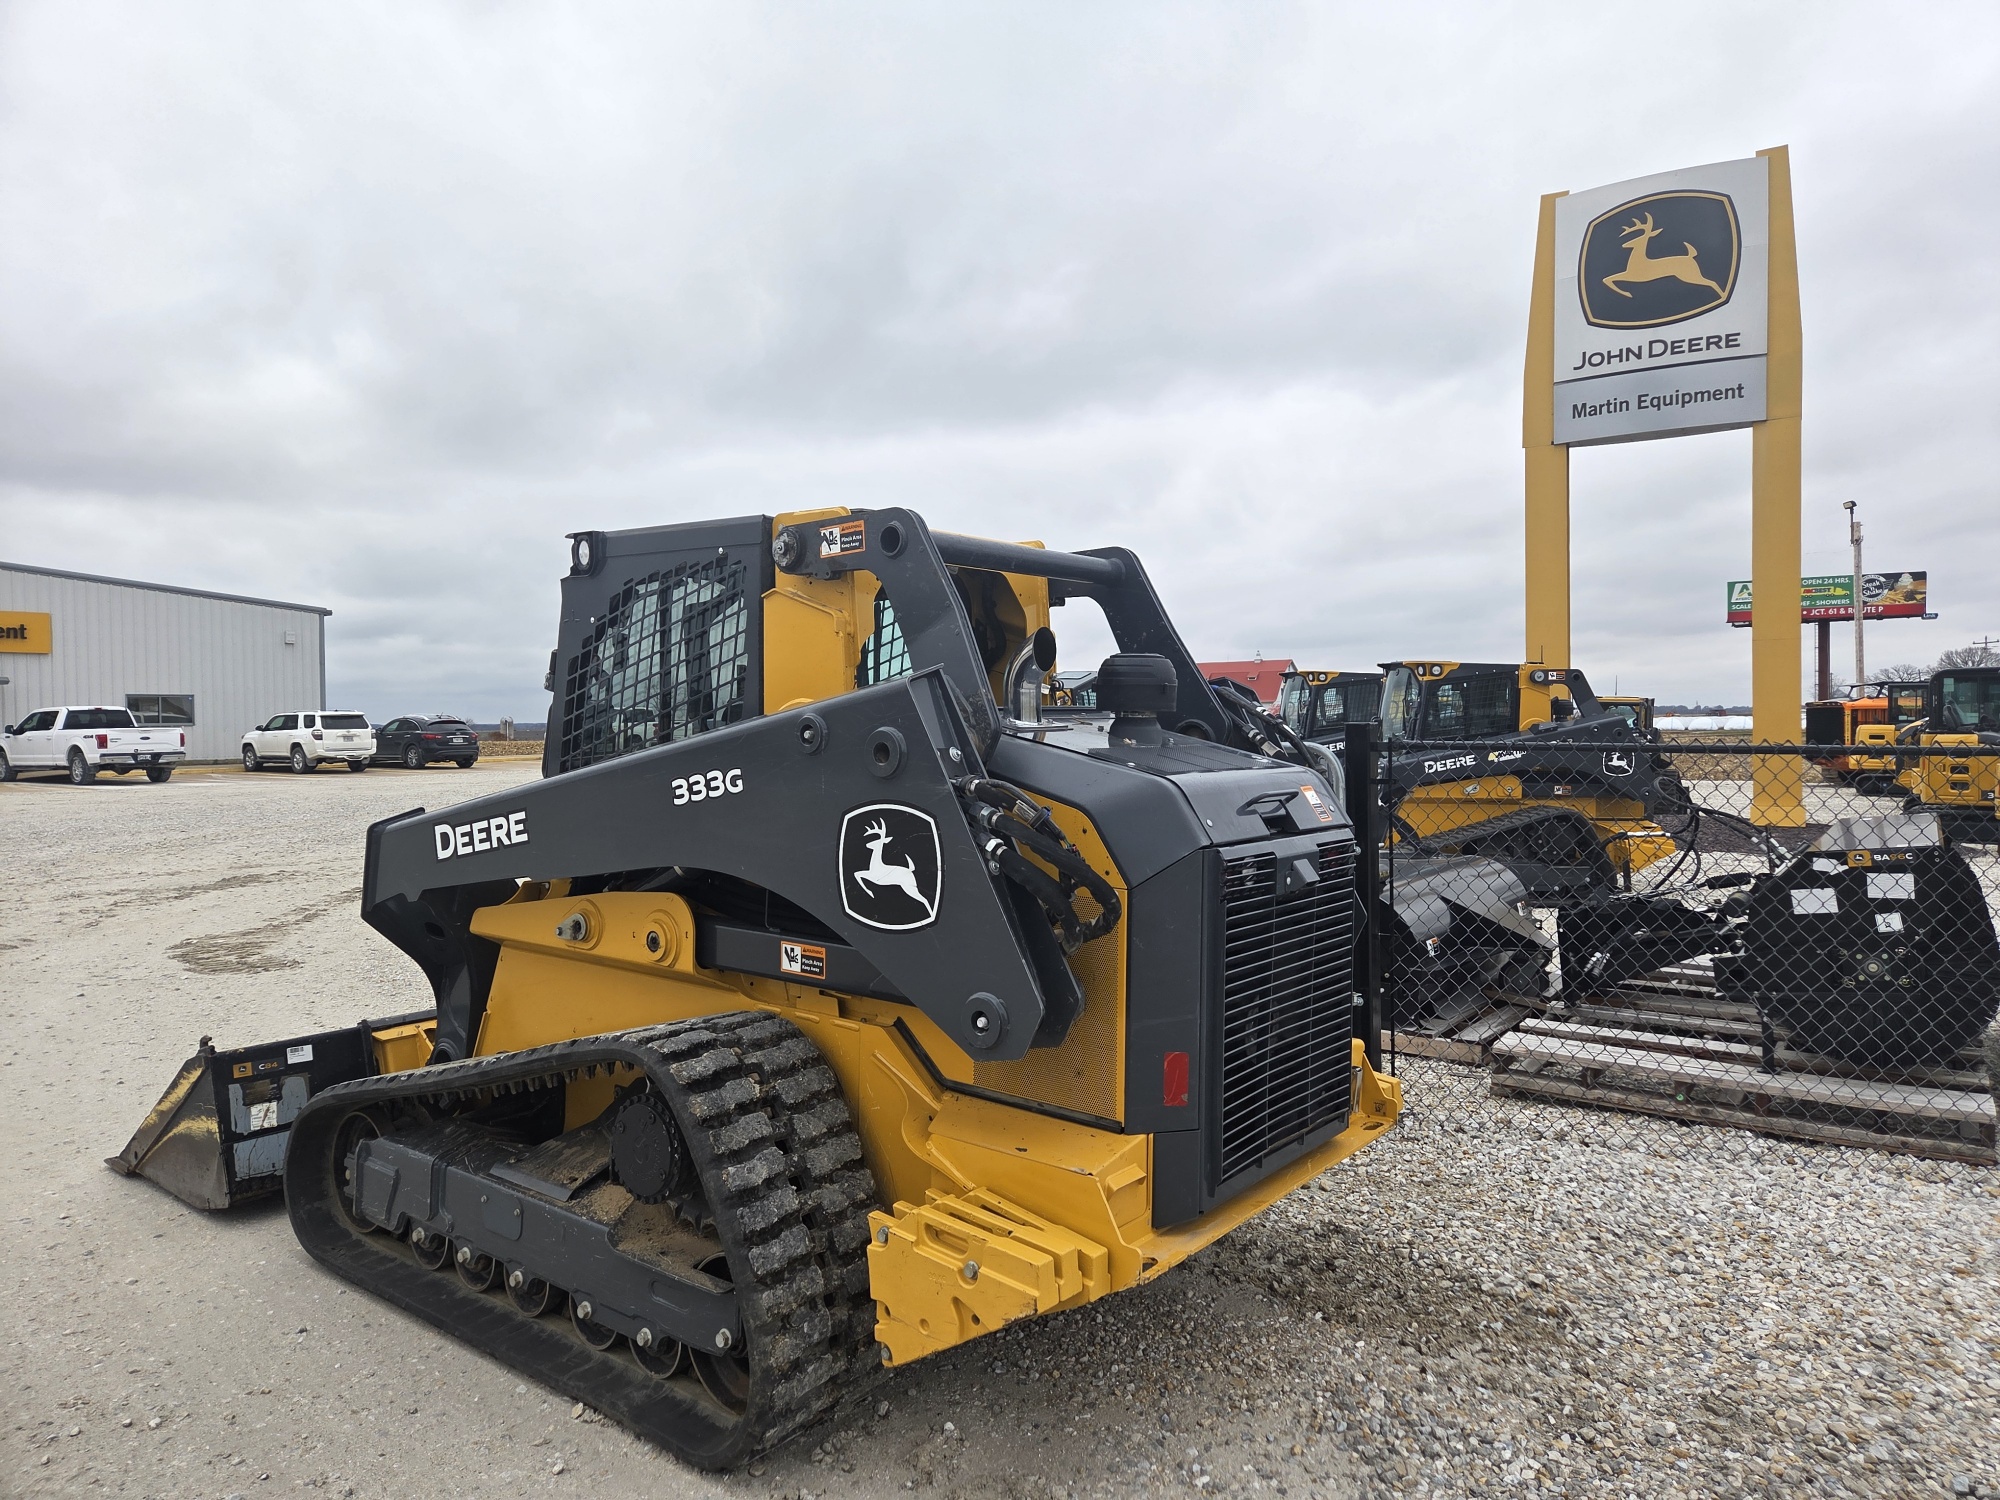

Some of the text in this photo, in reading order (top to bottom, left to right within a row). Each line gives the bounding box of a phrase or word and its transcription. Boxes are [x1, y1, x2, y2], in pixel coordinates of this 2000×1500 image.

[1573, 332, 1741, 370] JOHN DEERE
[1571, 383, 1744, 419] Martin Equipment
[1424, 755, 1476, 774] DEERE
[671, 768, 744, 806] 333G
[434, 811, 529, 860] DEERE
[258, 1061, 278, 1070] C84
